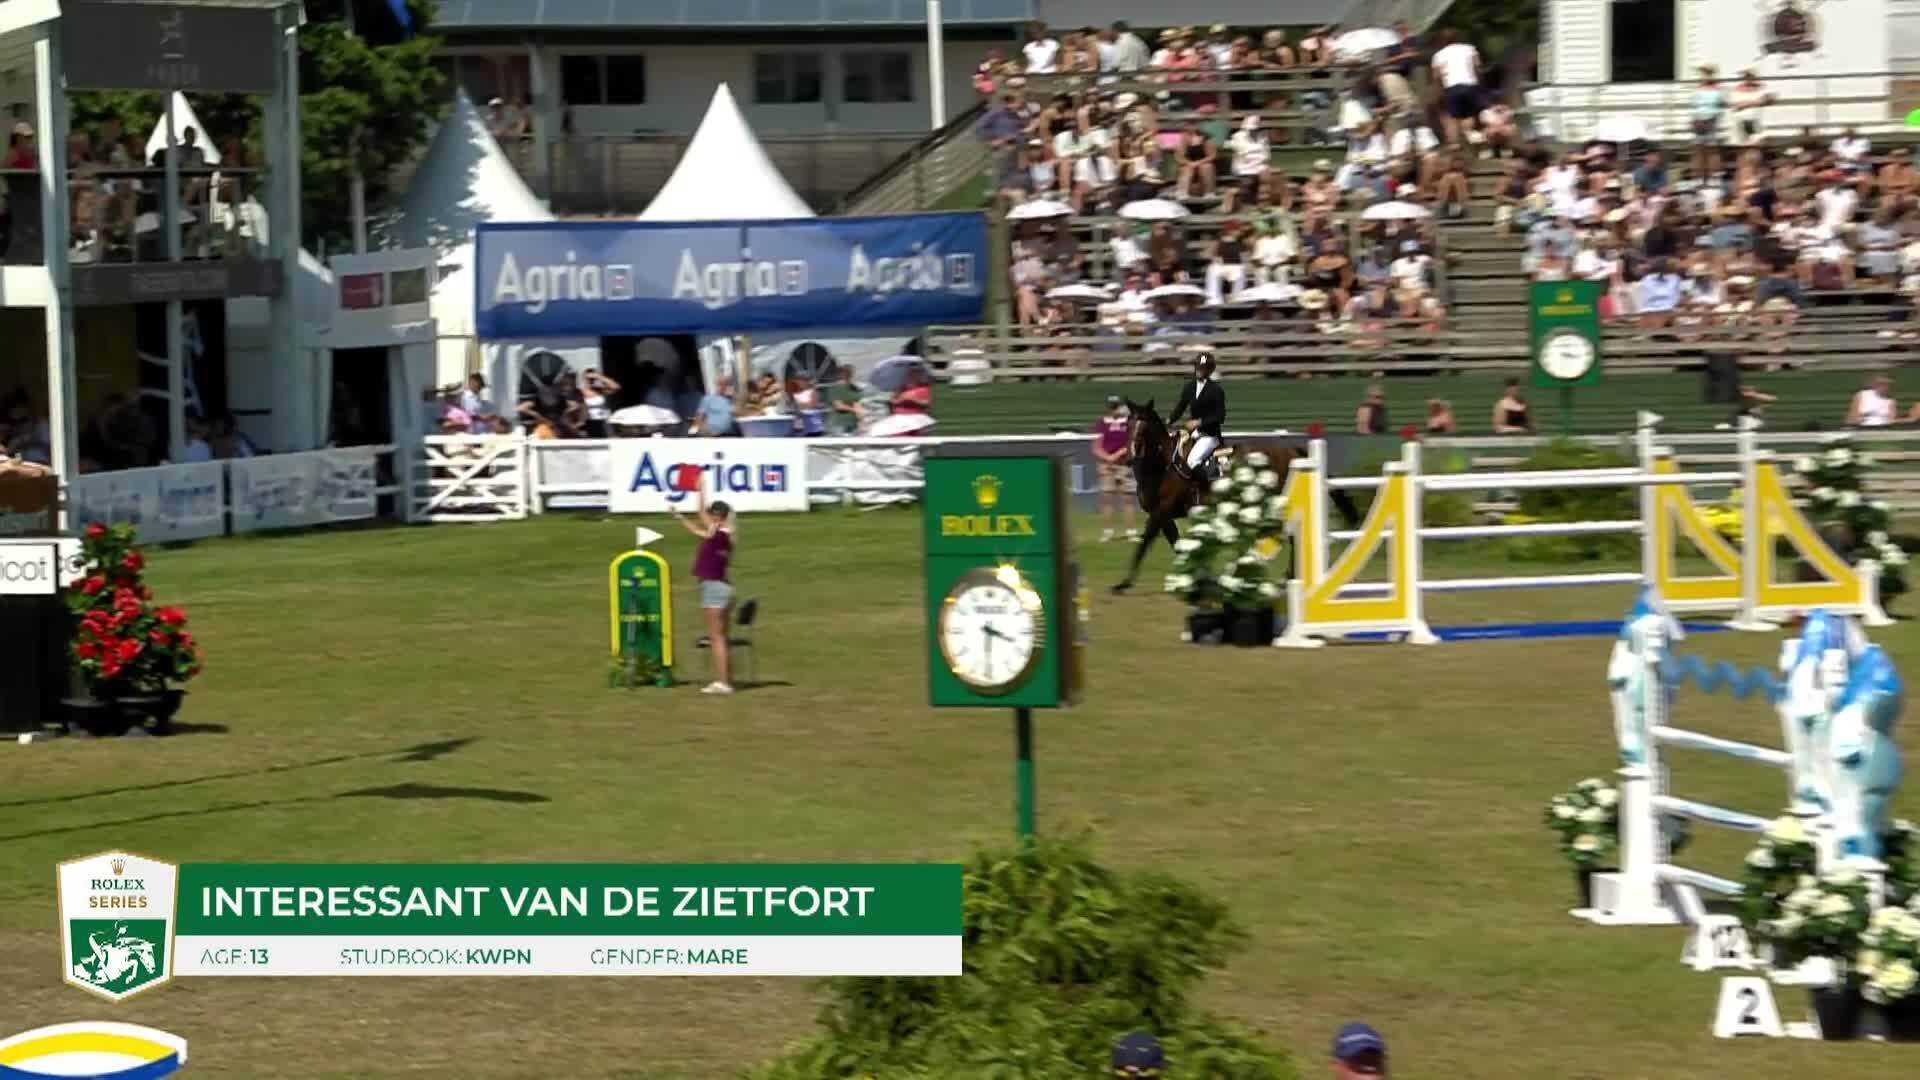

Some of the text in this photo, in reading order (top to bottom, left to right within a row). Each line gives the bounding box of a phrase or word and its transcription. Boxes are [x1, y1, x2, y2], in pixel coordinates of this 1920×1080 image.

[495, 251, 601, 314] Agria
[672, 248, 778, 309] Agria
[941, 514, 1036, 537] ROLEX
[1736, 988, 1760, 1025] 2
